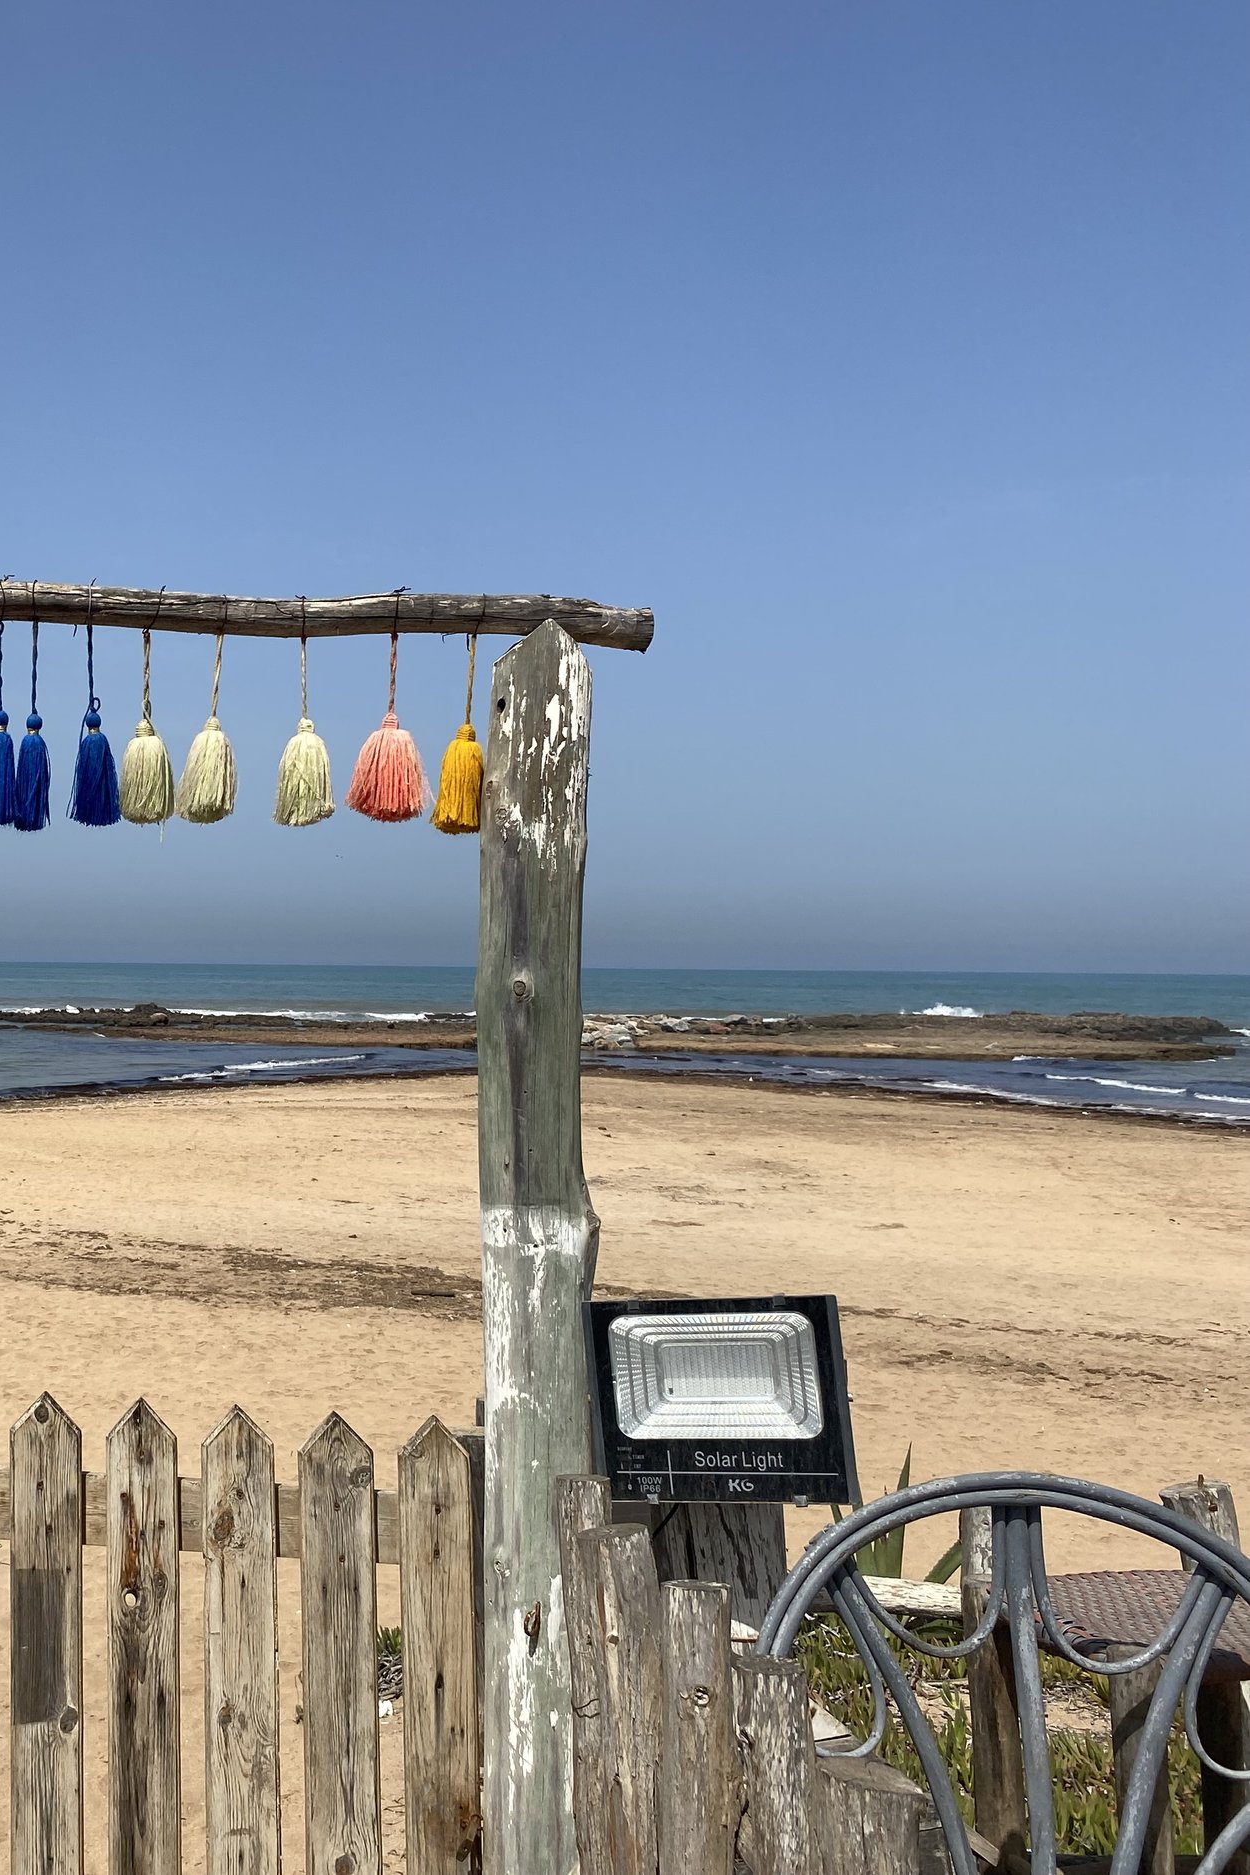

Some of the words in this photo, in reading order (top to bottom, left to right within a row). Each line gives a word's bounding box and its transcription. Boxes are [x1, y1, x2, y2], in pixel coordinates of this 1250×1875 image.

[694, 1450, 737, 1467] Solar
[742, 1451, 784, 1471] Light
[637, 1476, 662, 1485] 100W
[728, 1479, 755, 1492] KG
[640, 1484, 661, 1493] IP66
